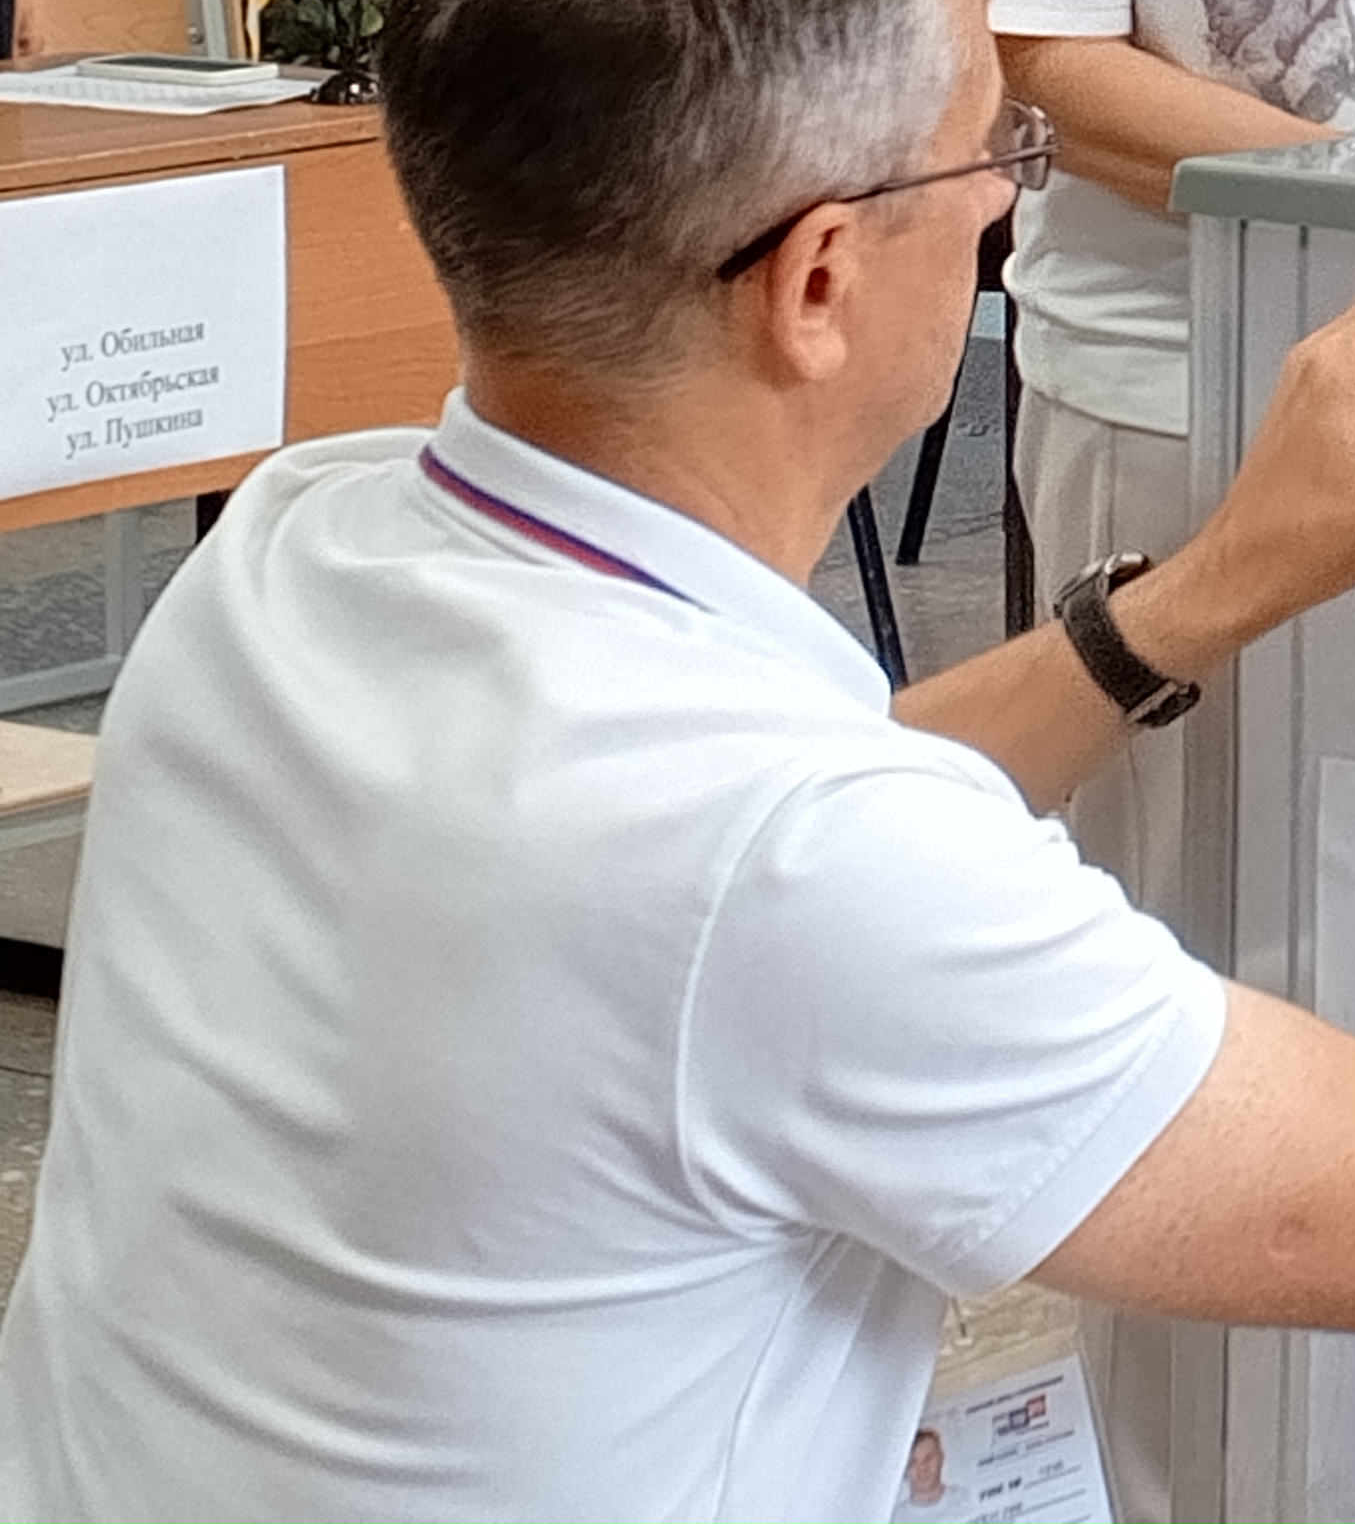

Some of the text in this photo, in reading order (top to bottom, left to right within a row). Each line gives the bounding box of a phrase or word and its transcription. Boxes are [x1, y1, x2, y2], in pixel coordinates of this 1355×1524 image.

[61, 322, 205, 371] ул. Обильная
[46, 365, 219, 423] ул. Октябрьская
[65, 409, 203, 459] ул. Пушкина
